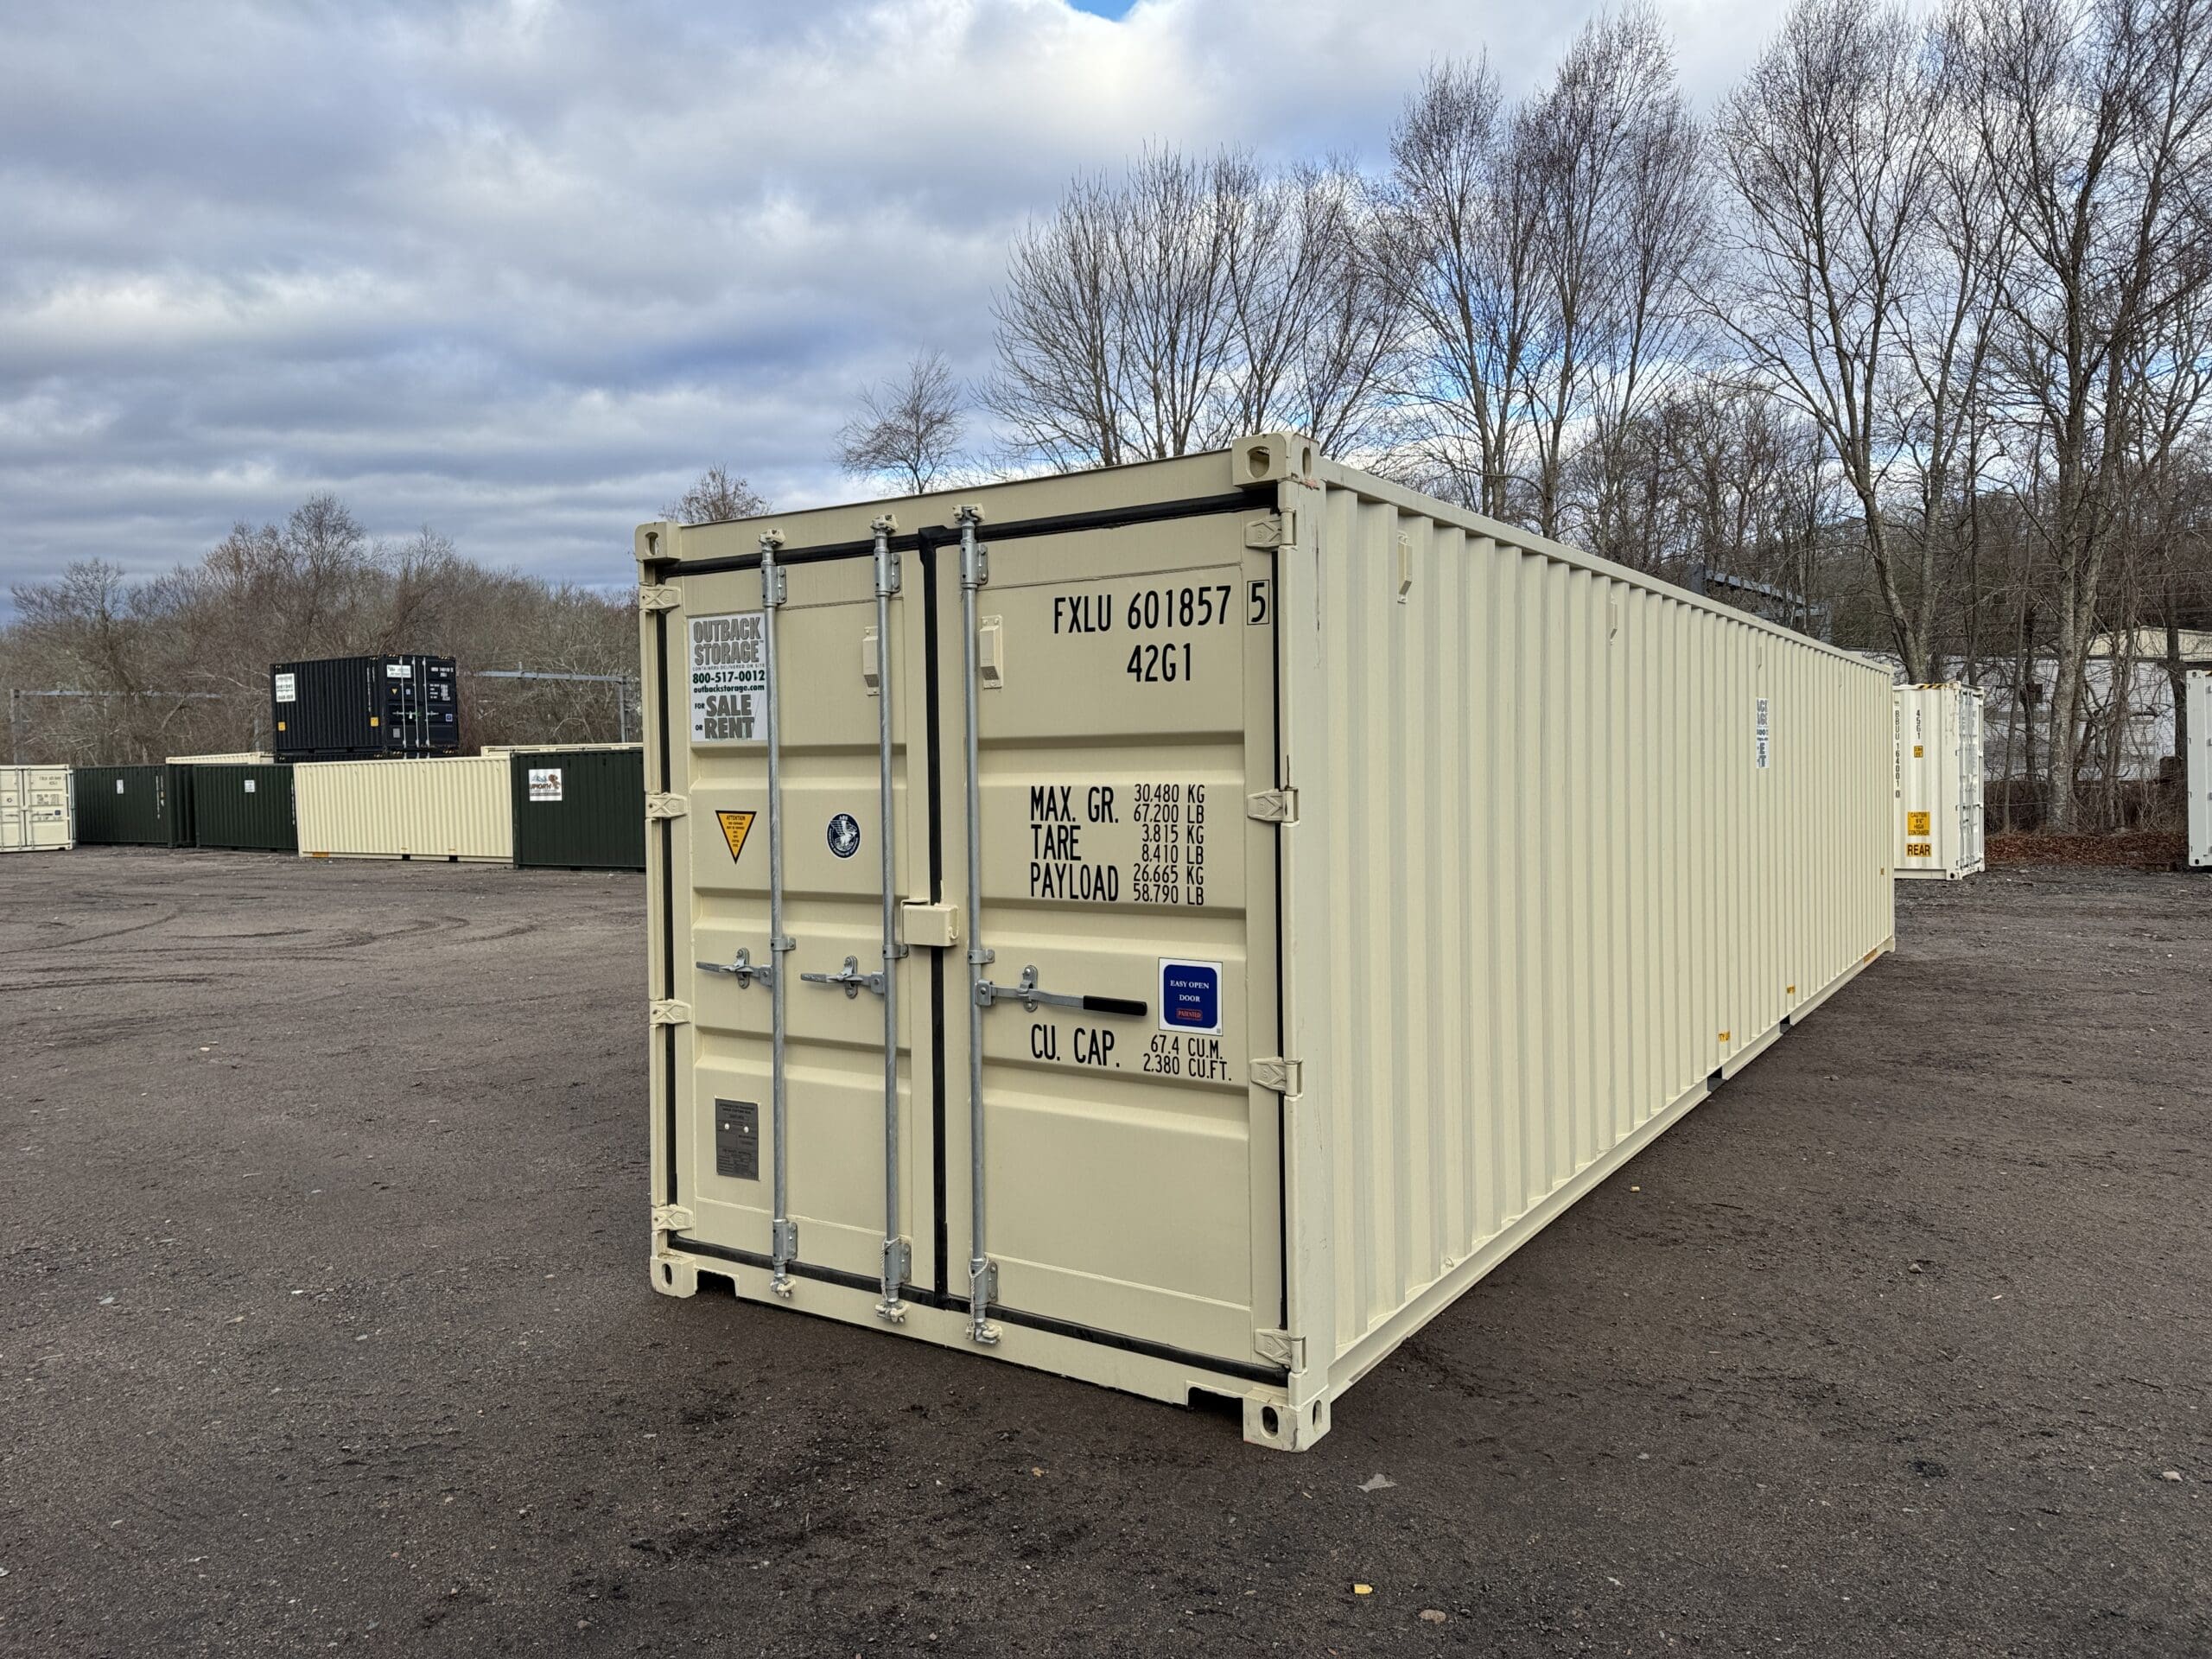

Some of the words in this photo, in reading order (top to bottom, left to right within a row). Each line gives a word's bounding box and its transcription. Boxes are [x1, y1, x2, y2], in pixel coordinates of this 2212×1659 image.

[1054, 594, 1111, 633] FXLU
[1128, 586, 1231, 629] 601857
[1251, 582, 1266, 623] 5
[694, 617, 761, 643] OUTBACK
[695, 640, 759, 665] STORAGE
[1127, 643, 1191, 682] 42G1
[693, 670, 765, 683] 800-517-0012
[693, 684, 765, 693] outbackstorage.com
[706, 695, 752, 716] SALE
[704, 717, 754, 739] RENT
[1031, 785, 1076, 822] MAX.
[1088, 786, 1119, 823] GR.
[1134, 784, 1179, 803] 30,480
[1187, 784, 1205, 804] KG
[1134, 804, 1179, 823] 67,200
[1187, 804, 1205, 823] LB
[1031, 824, 1081, 861] TARE
[1141, 823, 1179, 843] 3,815
[1187, 824, 1205, 844] KG
[1141, 843, 1179, 863] 8,410
[1187, 845, 1204, 865] LB
[1907, 844, 1930, 855] REAR
[1031, 862, 1119, 901] PAYLOAD
[1134, 863, 1179, 883] 26,665
[1187, 865, 1204, 885] KG
[1134, 883, 1179, 904] 58,790
[1187, 886, 1205, 906] LB
[1179, 994, 1200, 1002] DOOR
[1178, 1009, 1201, 1018] PATENTED
[1031, 1023, 1061, 1061] CU.
[1074, 1027, 1120, 1068] CAP.
[1151, 1034, 1179, 1055] 67.4
[1188, 1038, 1223, 1059] CU.M.
[1143, 1053, 1179, 1075] 2,380
[1189, 1058, 1231, 1081] CU.FT.
